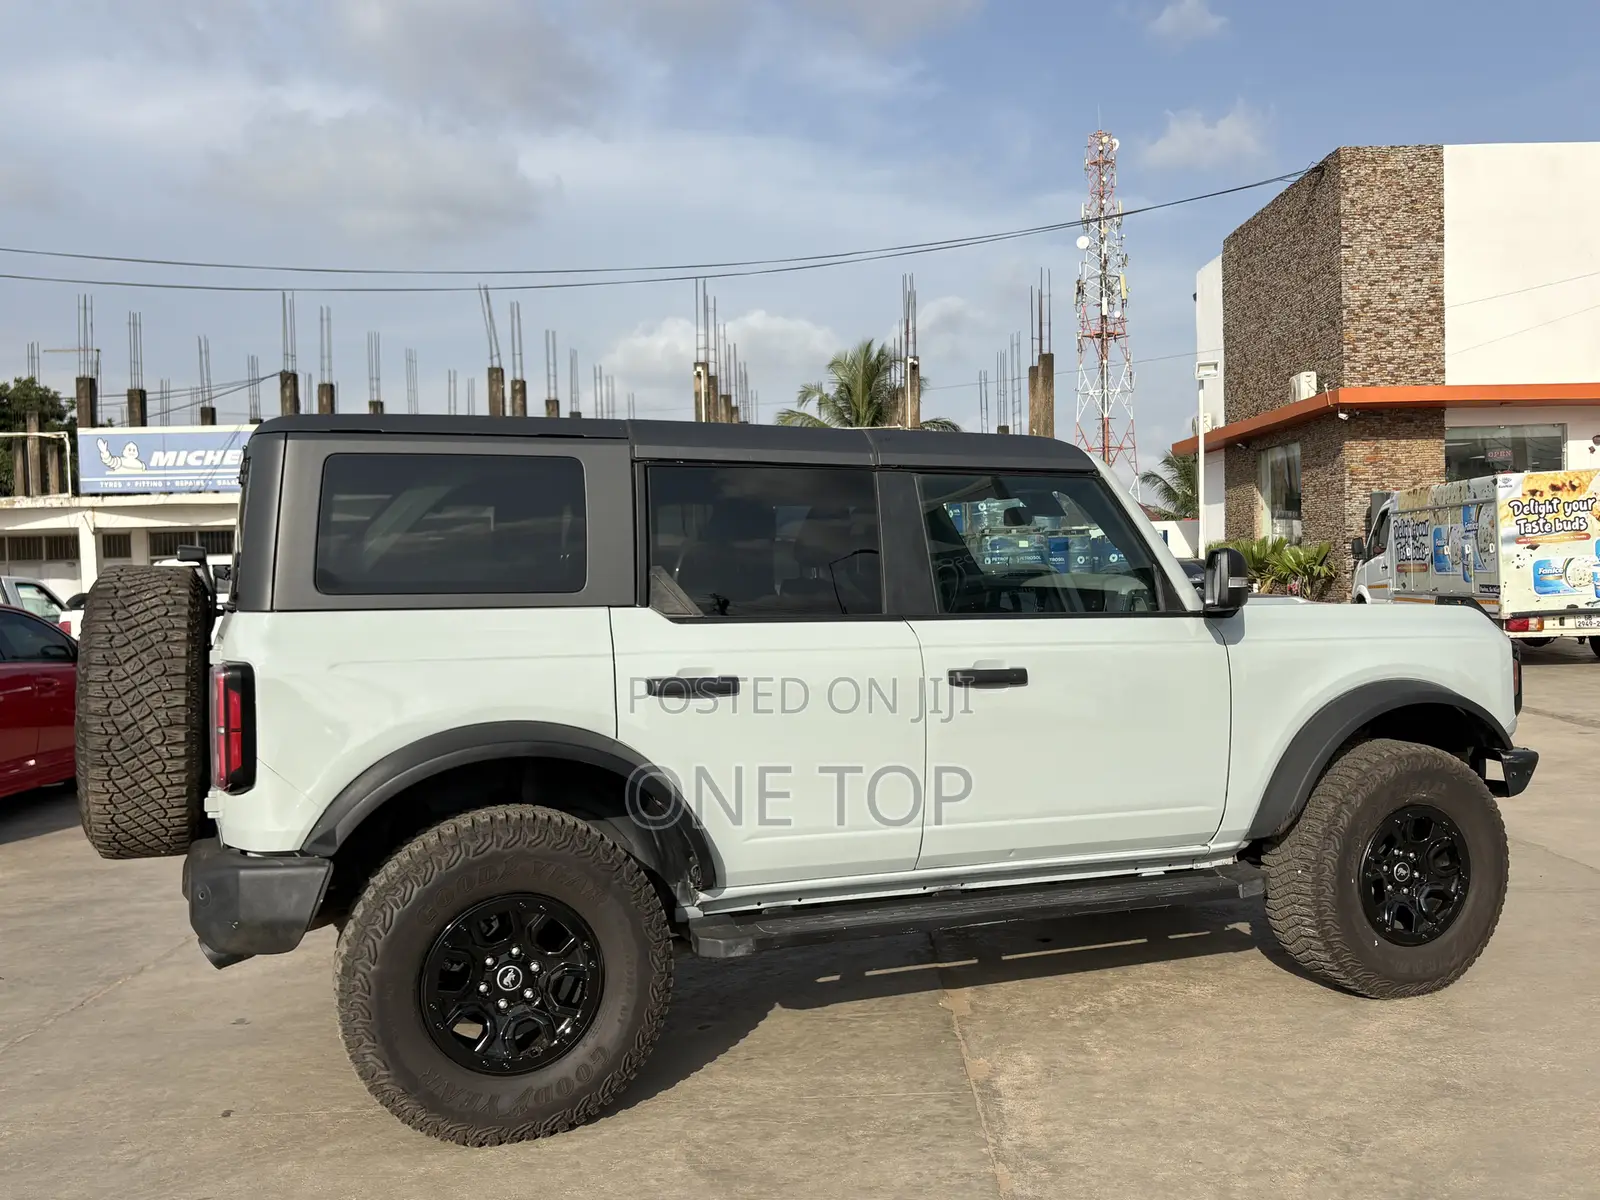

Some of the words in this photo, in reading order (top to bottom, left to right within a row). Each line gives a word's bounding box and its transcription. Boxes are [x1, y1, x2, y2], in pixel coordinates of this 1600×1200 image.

[150, 450, 244, 466] MICHE
[100, 480, 122, 488] TYRES
[134, 480, 163, 488] FITTING
[1508, 497, 1561, 518] Delight
[1563, 497, 1597, 517] your
[1516, 518, 1553, 535] Taste
[1554, 516, 1588, 532] buds
